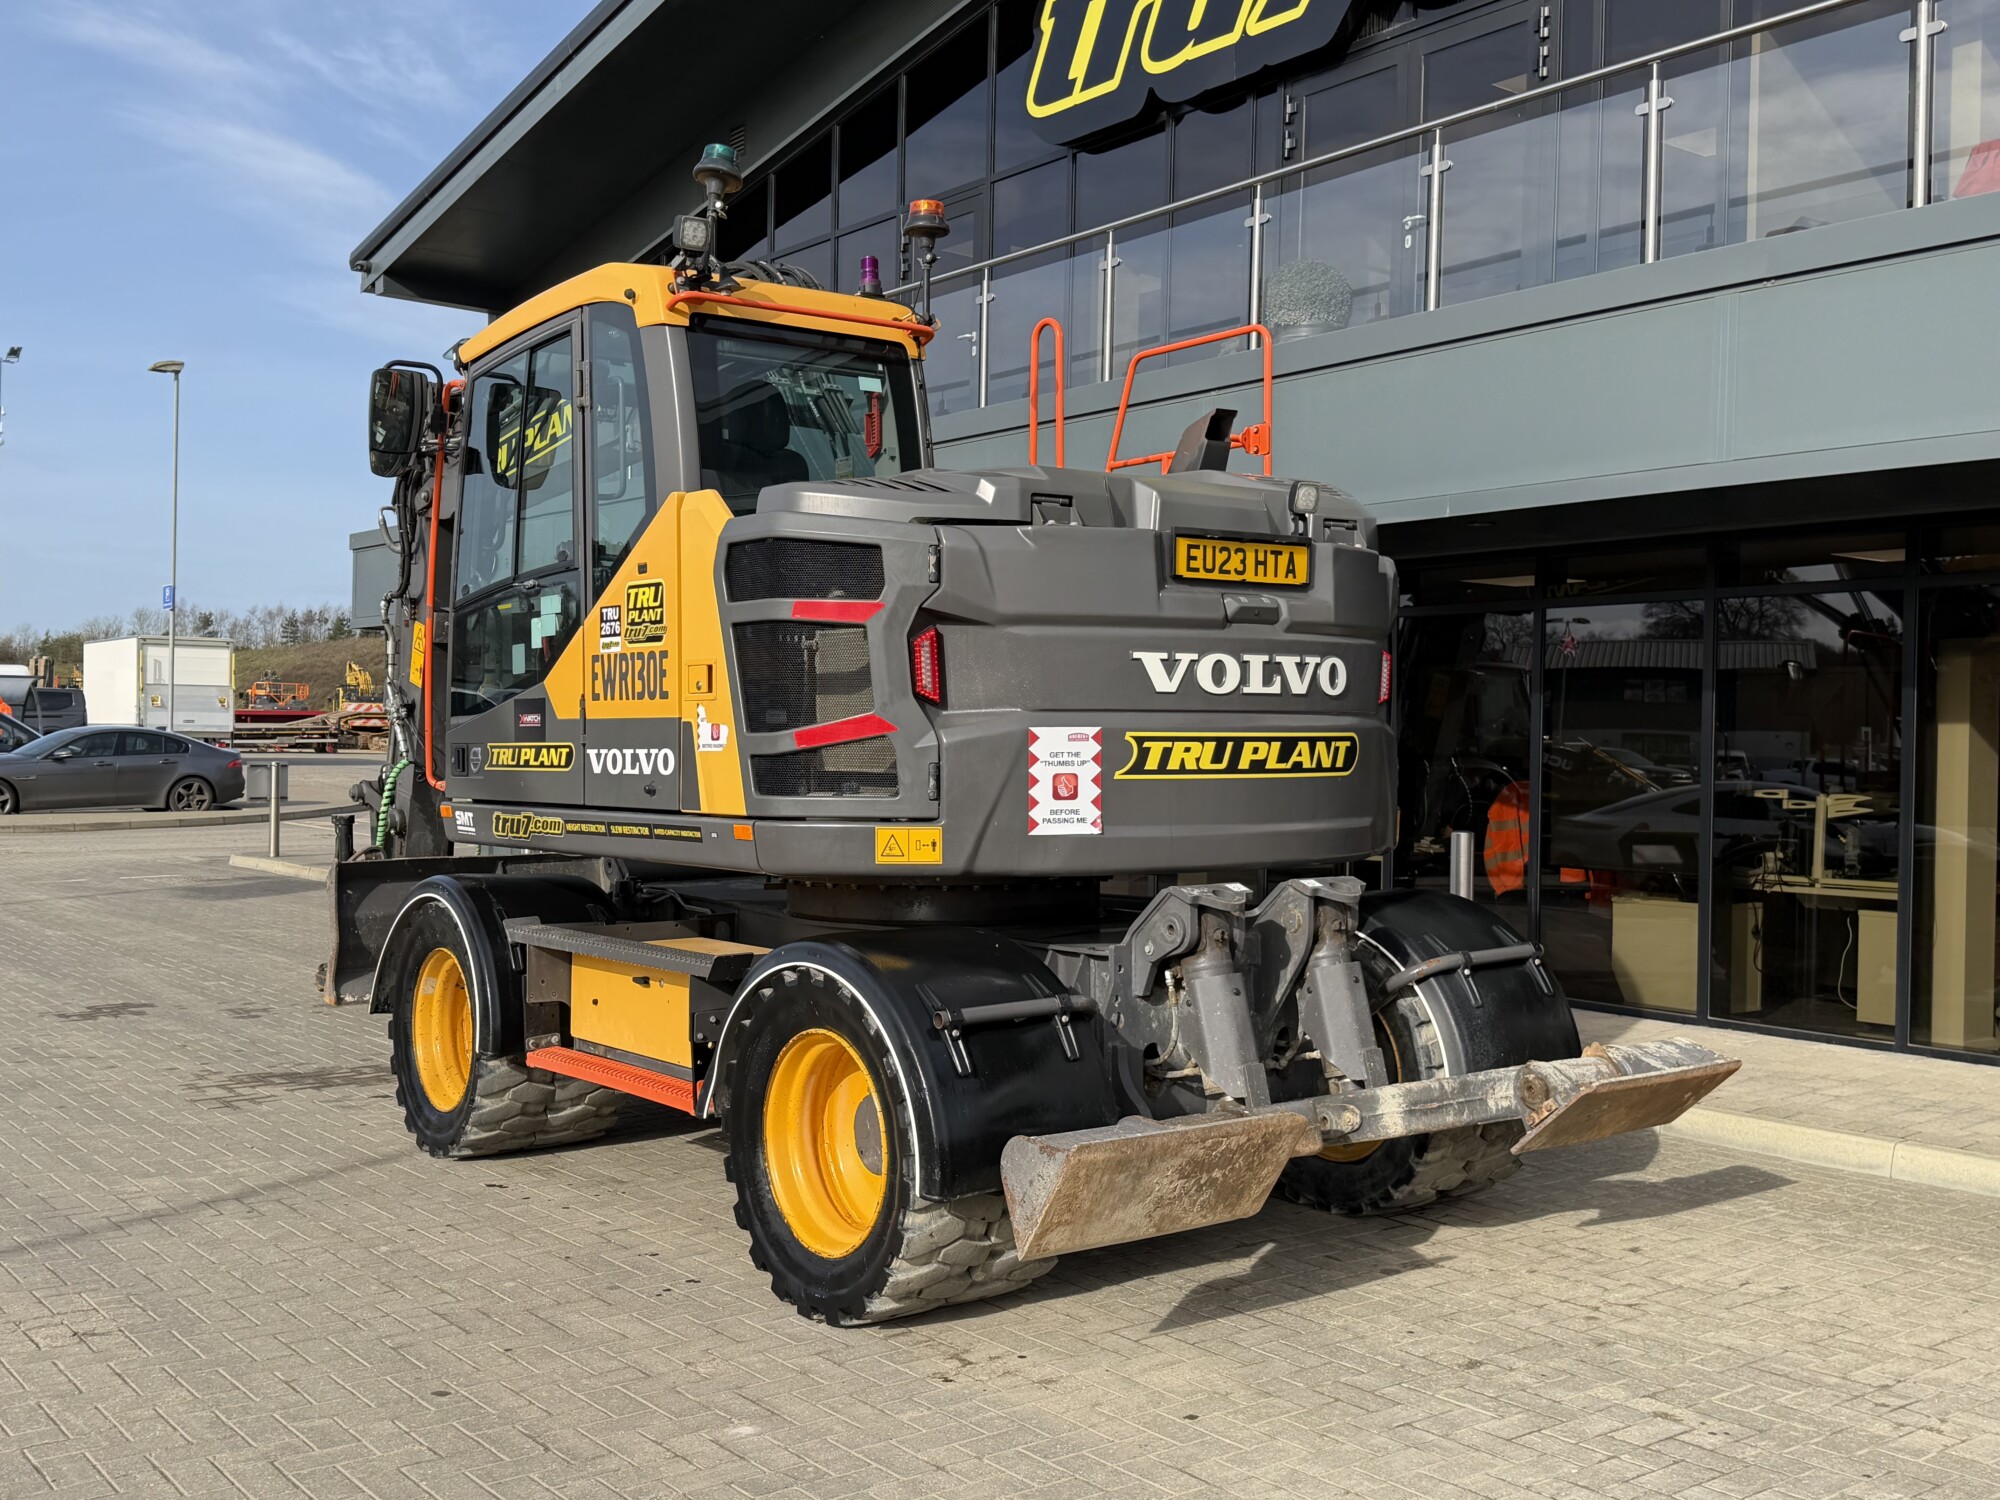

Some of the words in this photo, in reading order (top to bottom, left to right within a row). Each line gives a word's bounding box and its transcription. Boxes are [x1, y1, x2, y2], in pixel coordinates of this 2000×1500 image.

[1026, 0, 1311, 118] tru
[1186, 543, 1247, 576] EU23
[1254, 548, 1297, 579] HTA
[627, 585, 663, 609] TRU
[601, 606, 619, 620] TRU
[627, 608, 663, 623] PLANT
[600, 621, 621, 635] 2676
[591, 650, 669, 702] EWR130E
[1130, 650, 1348, 697] VOLVO
[491, 748, 519, 766] TRU
[519, 748, 570, 766] PLANT
[586, 747, 675, 776] VOLVO
[1049, 751, 1065, 759] GET
[1066, 751, 1082, 759] THE
[1142, 741, 1234, 770] TRU
[1237, 741, 1351, 770] PLANT
[455, 810, 474, 827] SMT
[1042, 817, 1075, 825] PASSING
[1049, 808, 1081, 816] BEFORE
[493, 812, 563, 838] tru7.com
